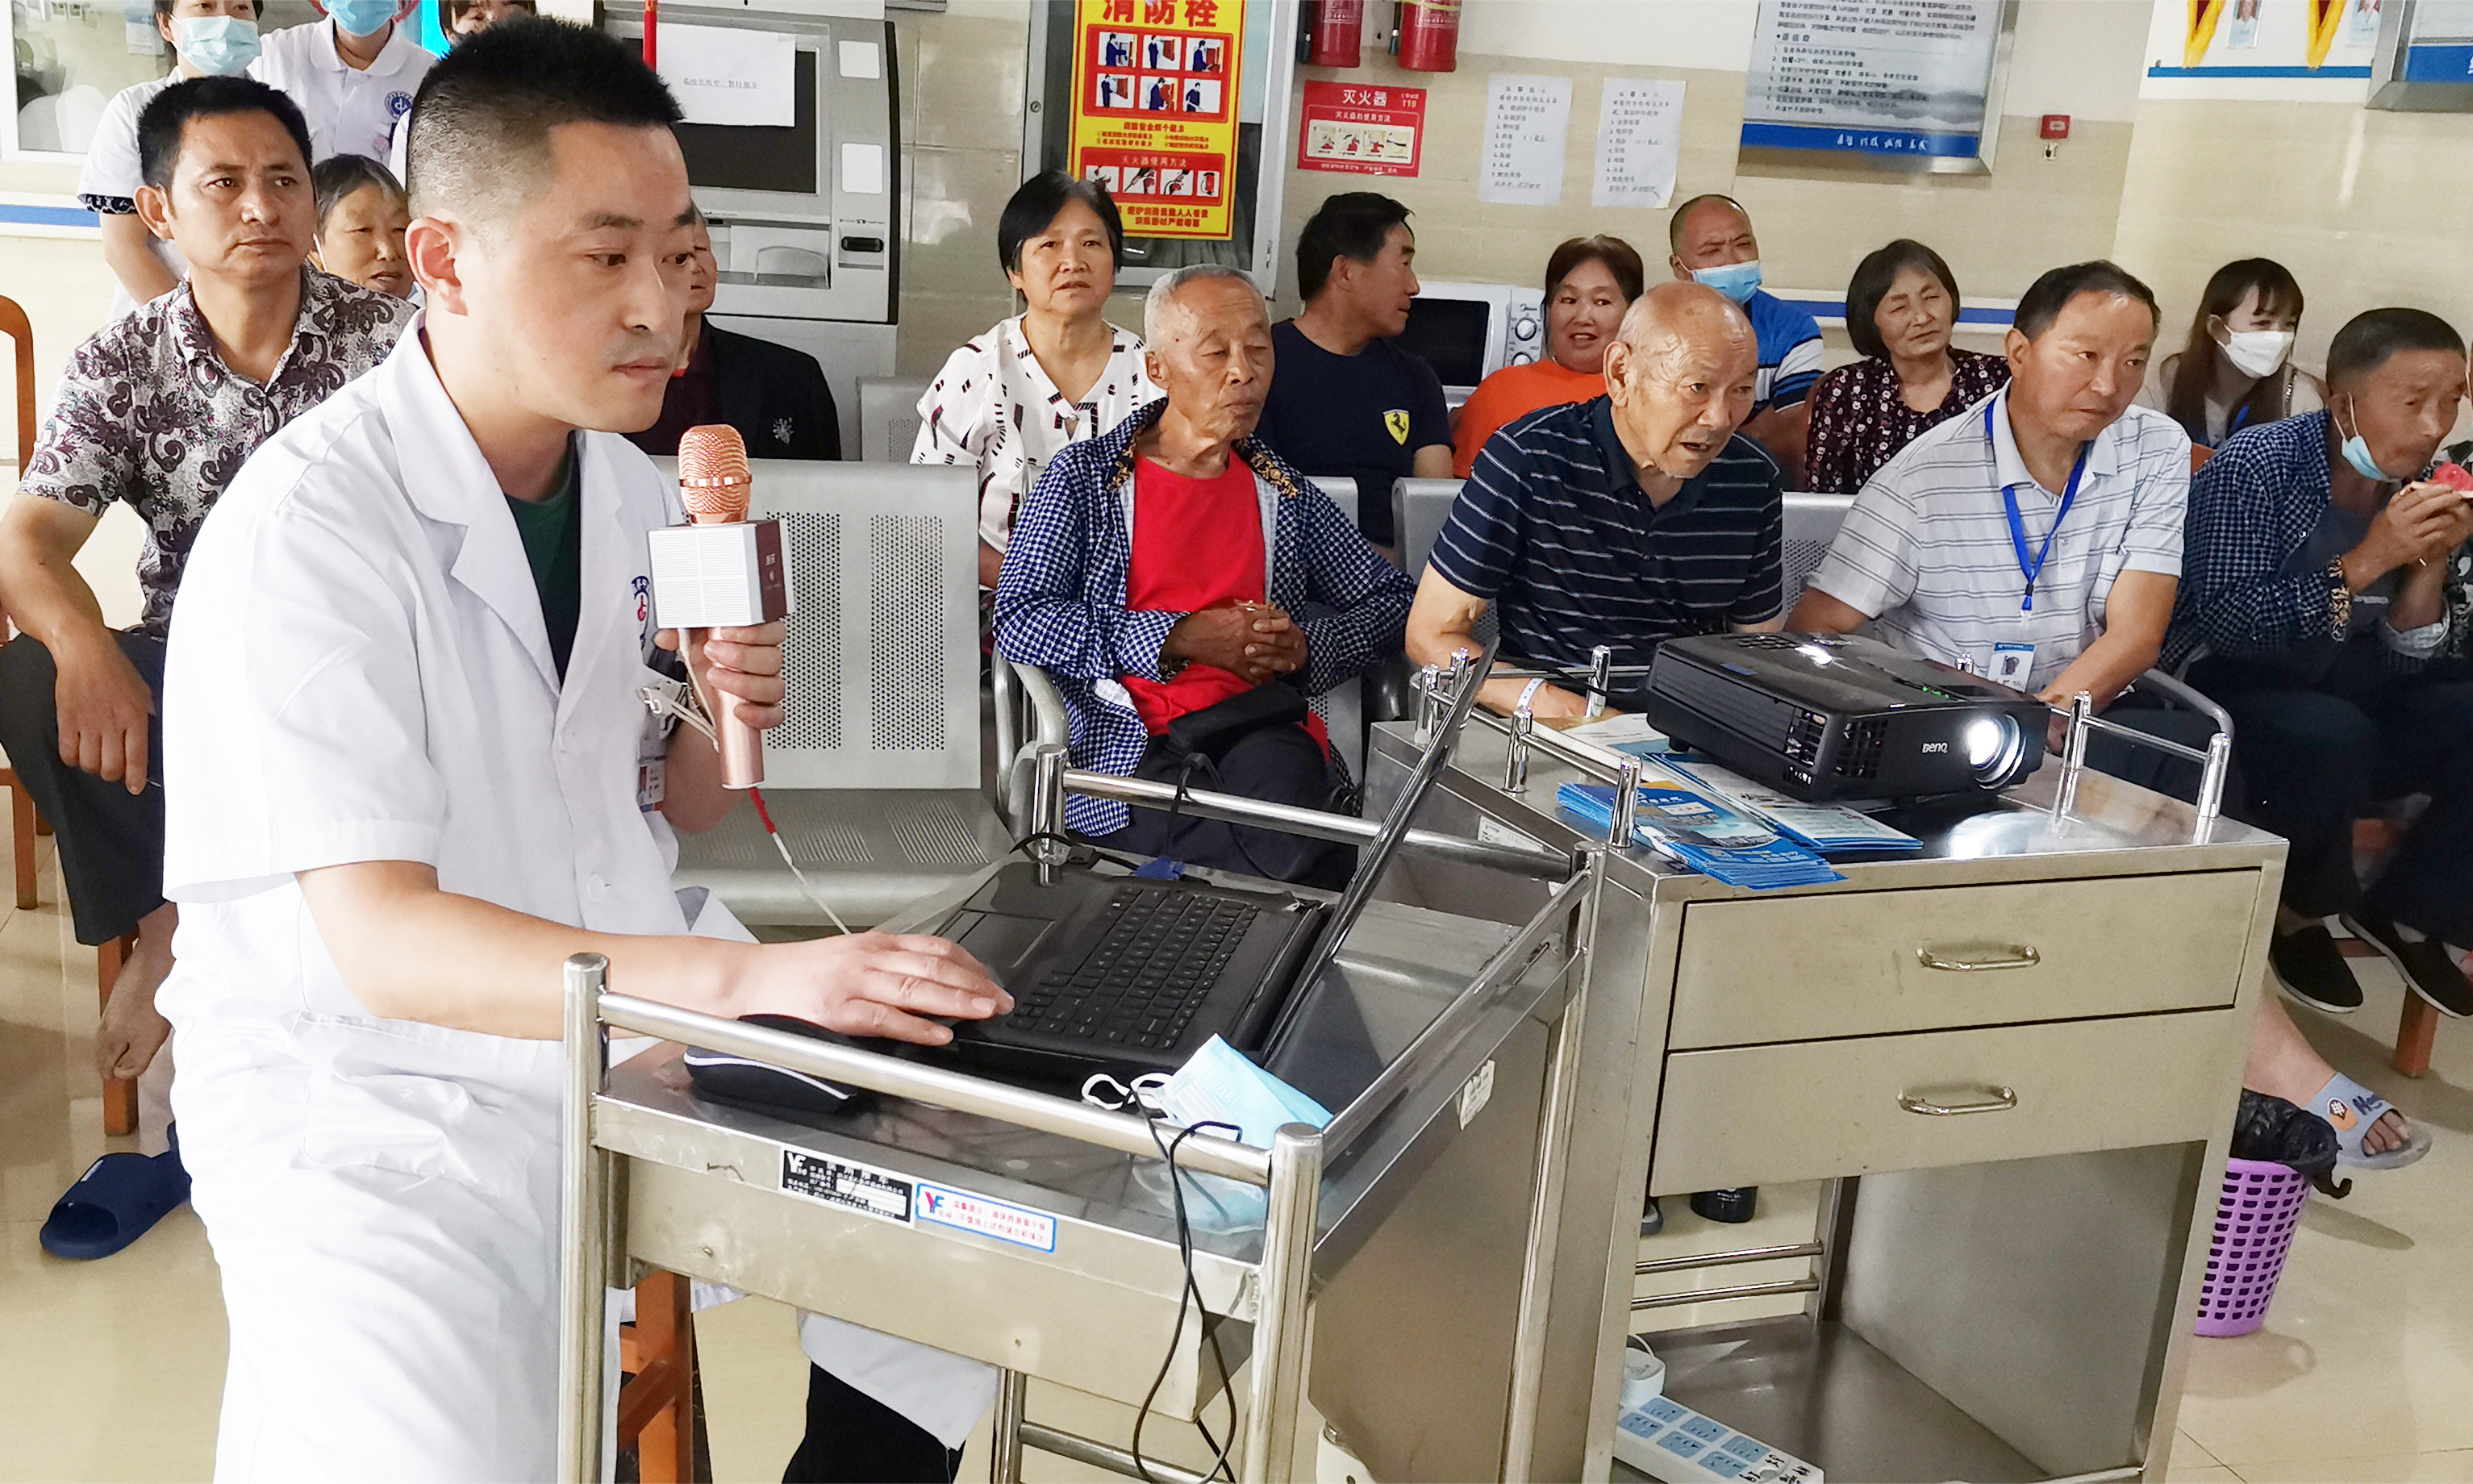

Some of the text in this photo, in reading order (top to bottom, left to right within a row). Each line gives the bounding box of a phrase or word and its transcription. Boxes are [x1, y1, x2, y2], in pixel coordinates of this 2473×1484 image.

[1342, 89, 1387, 106] 灭火器
[1402, 99, 1417, 108] 119
[1921, 742, 1949, 754] BenQ
